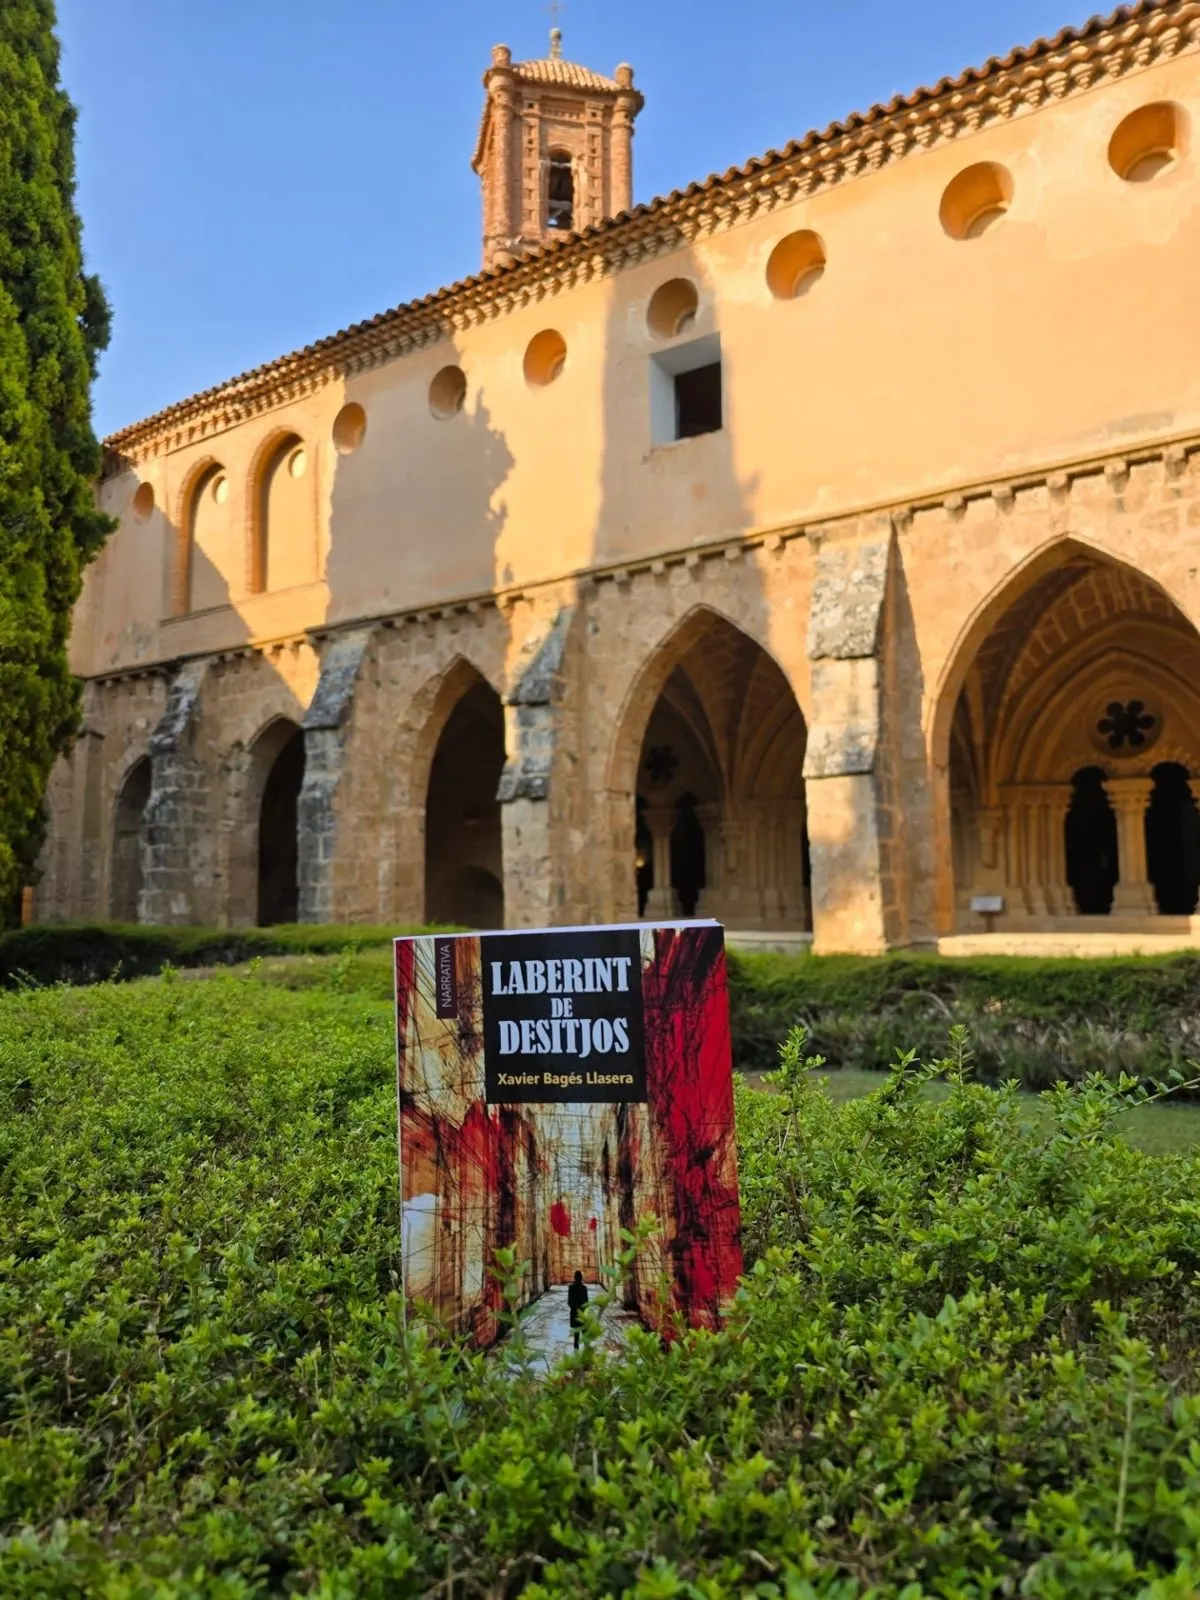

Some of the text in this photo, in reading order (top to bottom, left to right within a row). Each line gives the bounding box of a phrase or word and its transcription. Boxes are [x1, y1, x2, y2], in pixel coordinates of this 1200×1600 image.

[441, 944, 451, 1007] NARRATIVA
[491, 957, 631, 995] LABERINT
[551, 998, 573, 1017] DE
[498, 1017, 630, 1058] DESITJOS
[498, 1071, 633, 1087] Xavier Bagés Llasera
